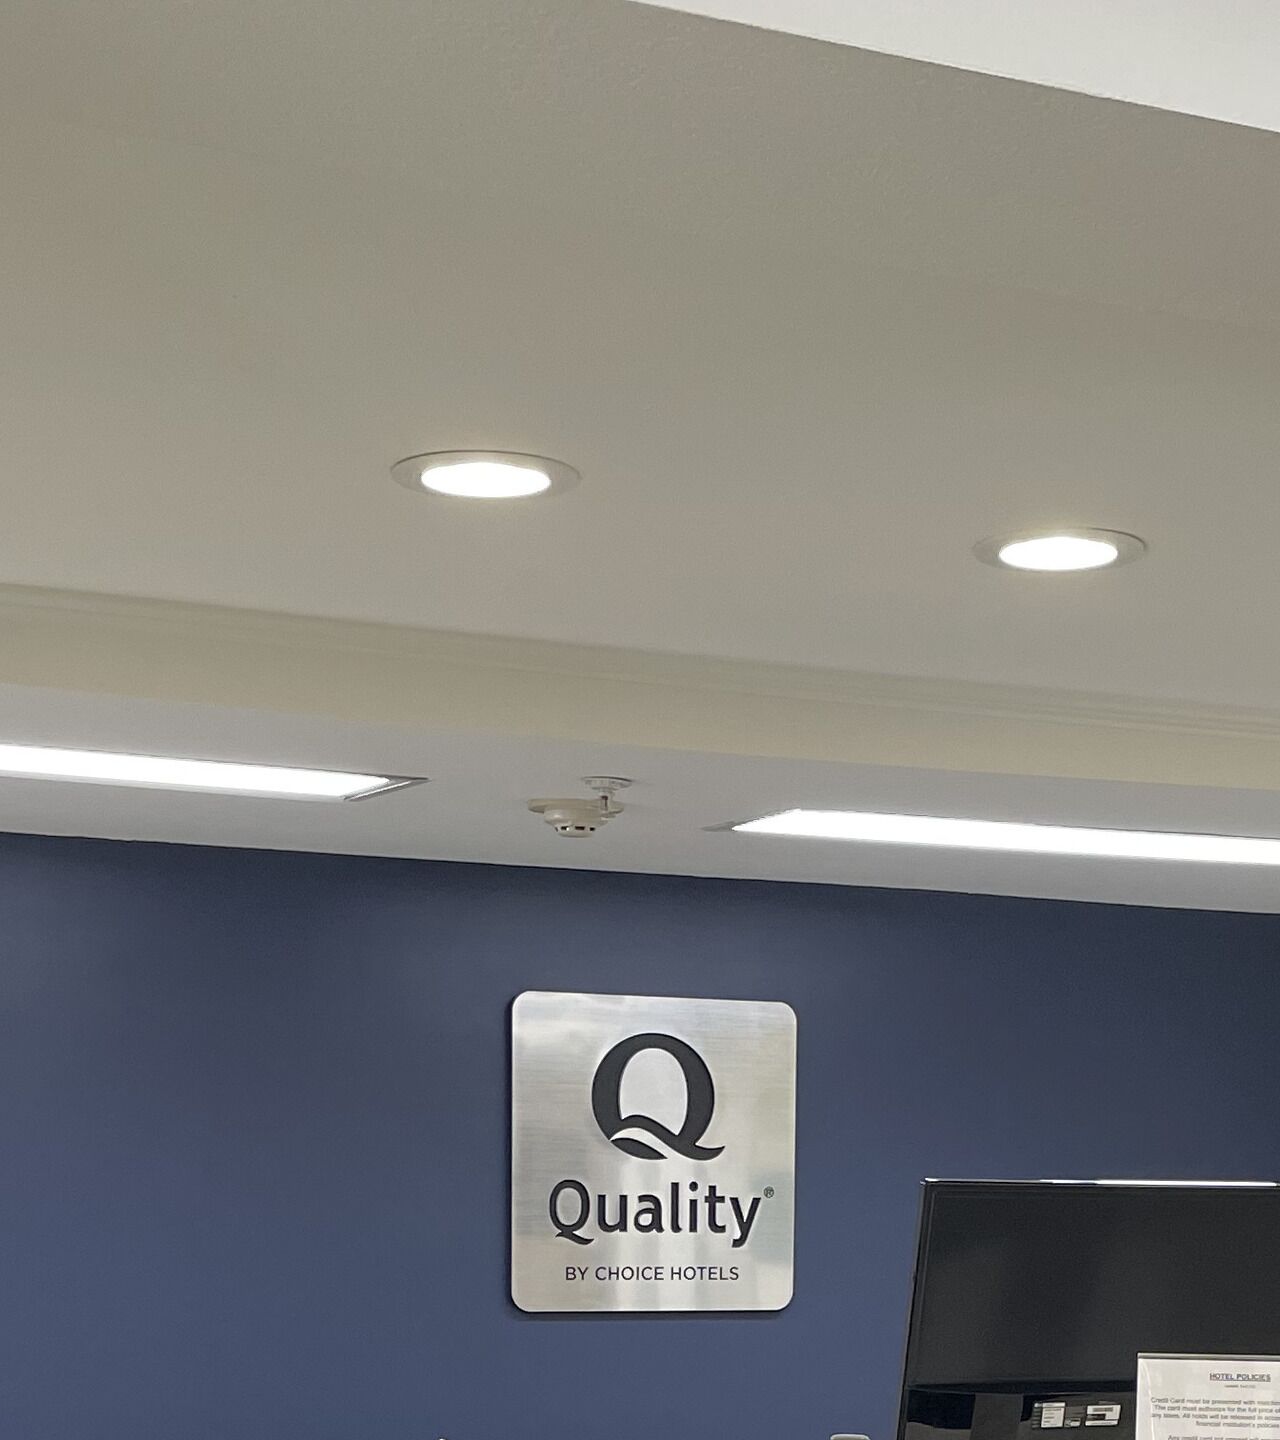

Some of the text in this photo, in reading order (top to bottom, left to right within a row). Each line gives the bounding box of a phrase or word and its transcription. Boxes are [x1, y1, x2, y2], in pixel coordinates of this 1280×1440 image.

[591, 1032, 725, 1161] Q
[549, 1179, 761, 1249] Quality
[565, 1266, 740, 1281] BY CHOICE HOTELS
[1209, 1373, 1271, 1382] HOTEL POLICIES
